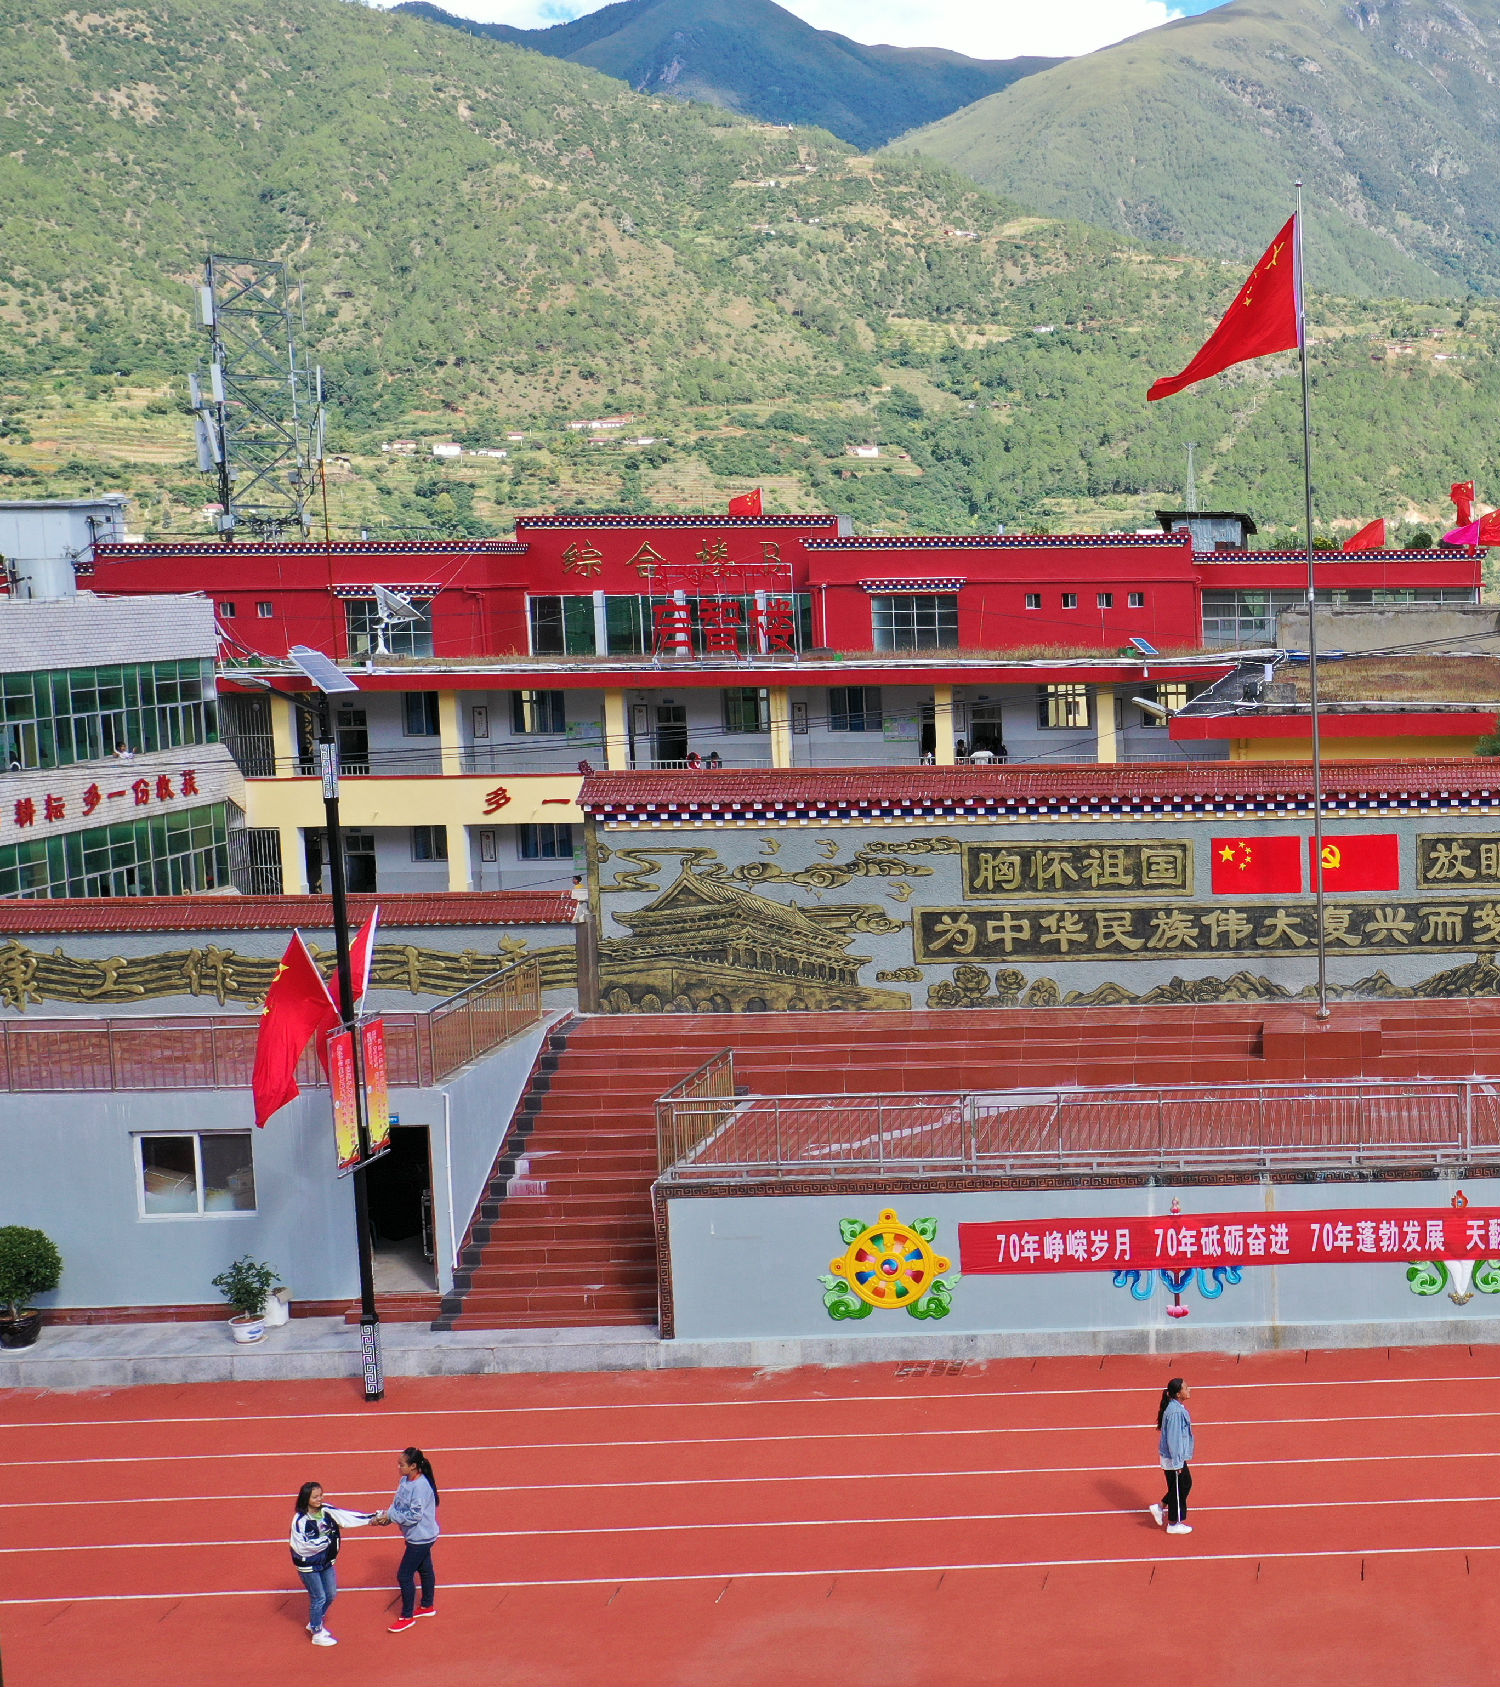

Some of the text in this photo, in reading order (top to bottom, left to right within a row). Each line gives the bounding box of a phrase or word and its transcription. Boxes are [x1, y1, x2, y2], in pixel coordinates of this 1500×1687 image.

[14, 793, 66, 828] 耕耘
[482, 786, 572, 815] 多一
[973, 847, 1187, 893] 胸怀祖国
[996, 1228, 1132, 1263] 70年峥嵘岁月
[1154, 1222, 1290, 1257] 70年砥砺奋进
[1310, 1219, 1446, 1253] 70年蓬勃发展
